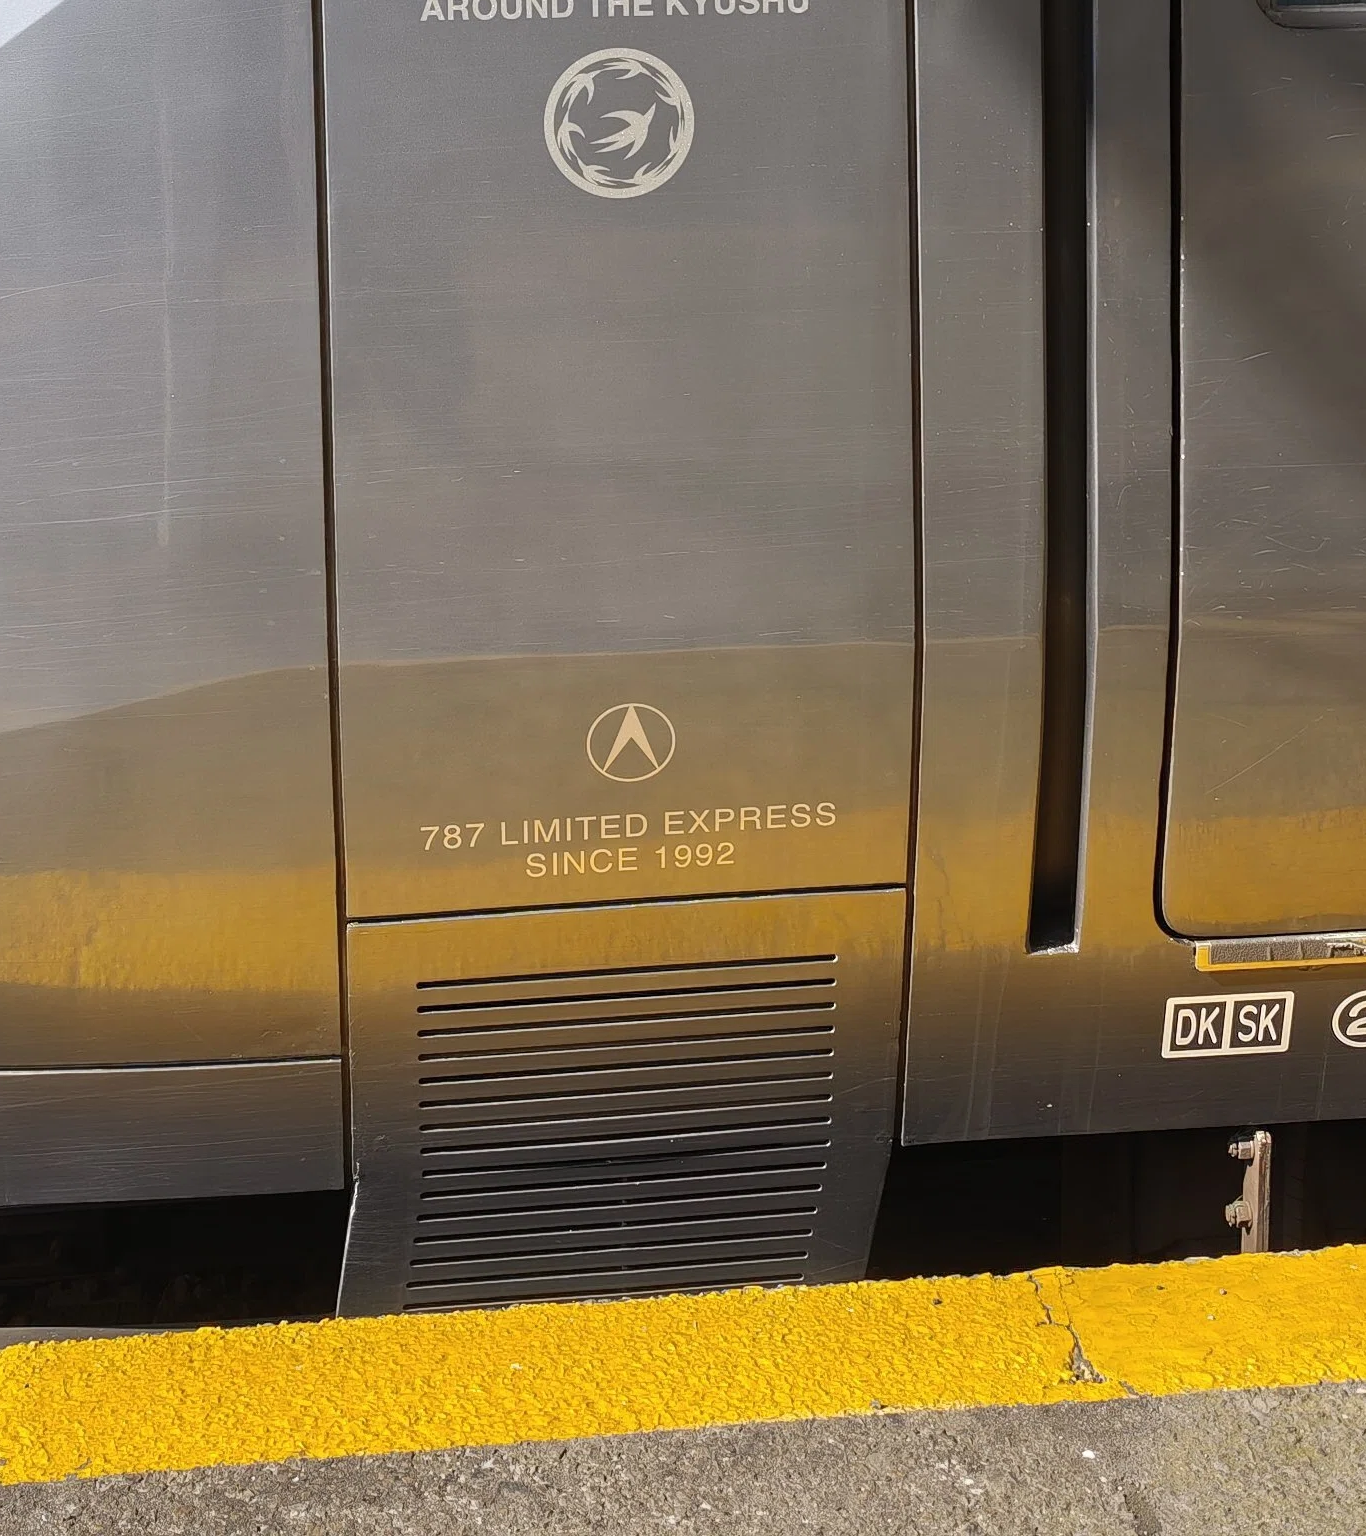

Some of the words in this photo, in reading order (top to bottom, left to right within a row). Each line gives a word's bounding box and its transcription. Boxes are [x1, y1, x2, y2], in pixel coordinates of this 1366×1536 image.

[420, 822, 485, 851] 787
[500, 813, 648, 846] LIMITED
[664, 802, 837, 835] EXPRESS
[525, 847, 638, 878] SINCE
[655, 842, 735, 869] 1992
